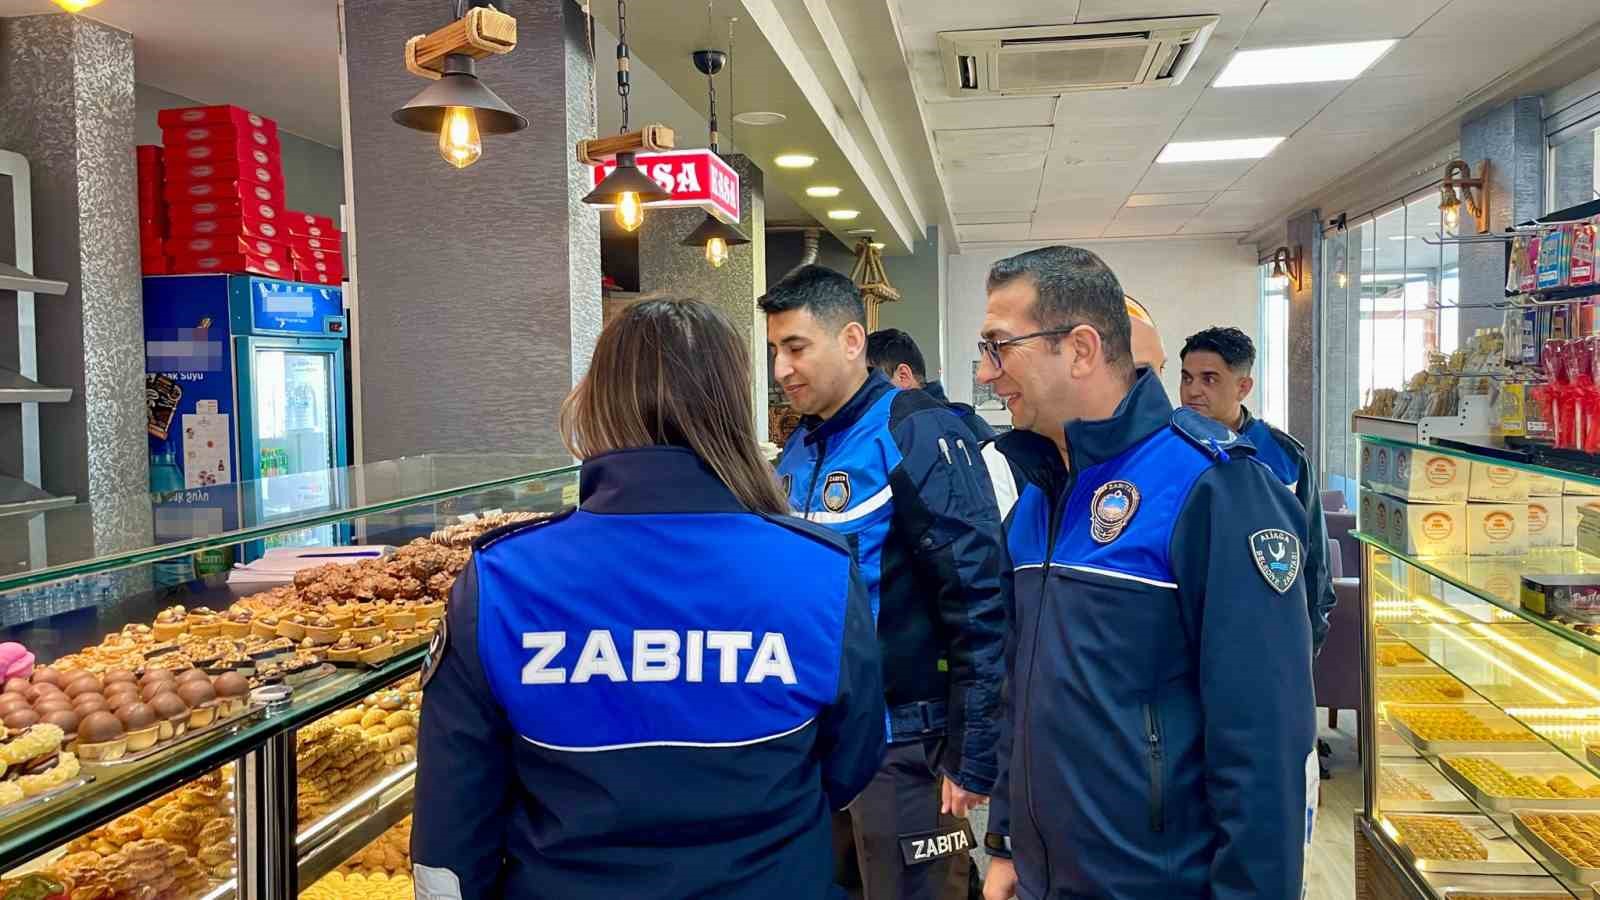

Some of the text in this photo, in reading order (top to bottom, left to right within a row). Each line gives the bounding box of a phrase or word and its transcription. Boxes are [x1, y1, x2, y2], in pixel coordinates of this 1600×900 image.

[711, 163, 737, 209] KASA
[521, 629, 798, 685] ZABITA
[911, 829, 969, 860] ZABITA
